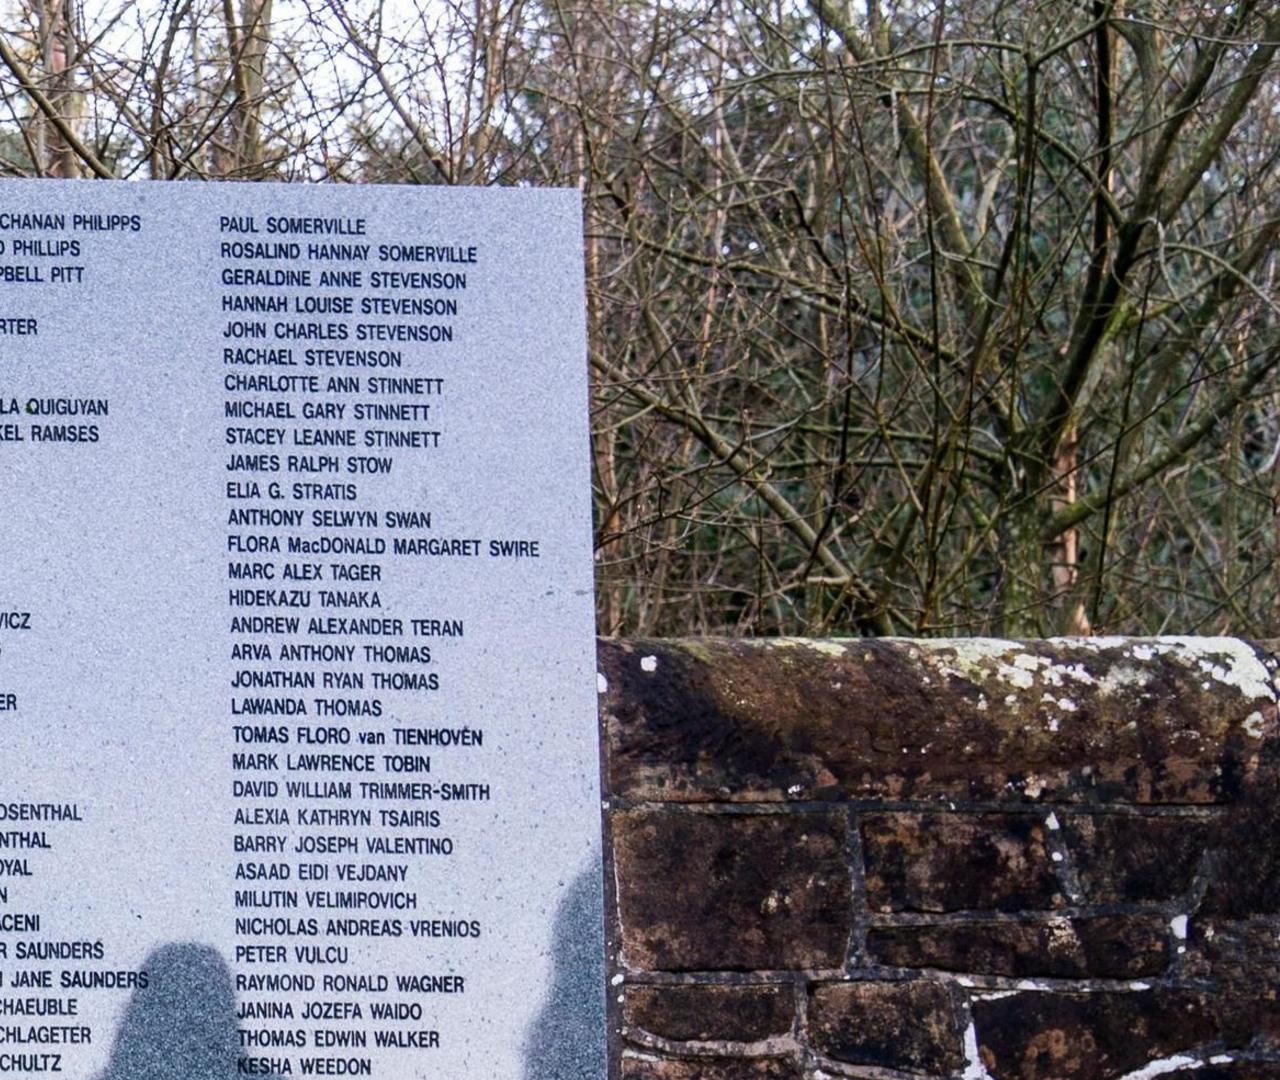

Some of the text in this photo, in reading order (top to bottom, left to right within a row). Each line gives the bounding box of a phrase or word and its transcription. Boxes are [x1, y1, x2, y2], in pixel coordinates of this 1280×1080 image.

[72, 214, 141, 232] PHILIPPS
[219, 216, 366, 236] PAUL SOMERVILLE
[12, 239, 81, 257] PHILLIPS
[220, 241, 478, 264] ROSALIND HANNAY SOMERVILLE
[221, 268, 467, 290] GERALDINE ANNE STEVENSON
[225, 454, 393, 474] JAMES RALPH STOW
[231, 698, 383, 717] LAWANDA THOMAS
[235, 945, 349, 965] PETER VULCU
[236, 1028, 440, 1049] THOMAS EDWIN WALKER
